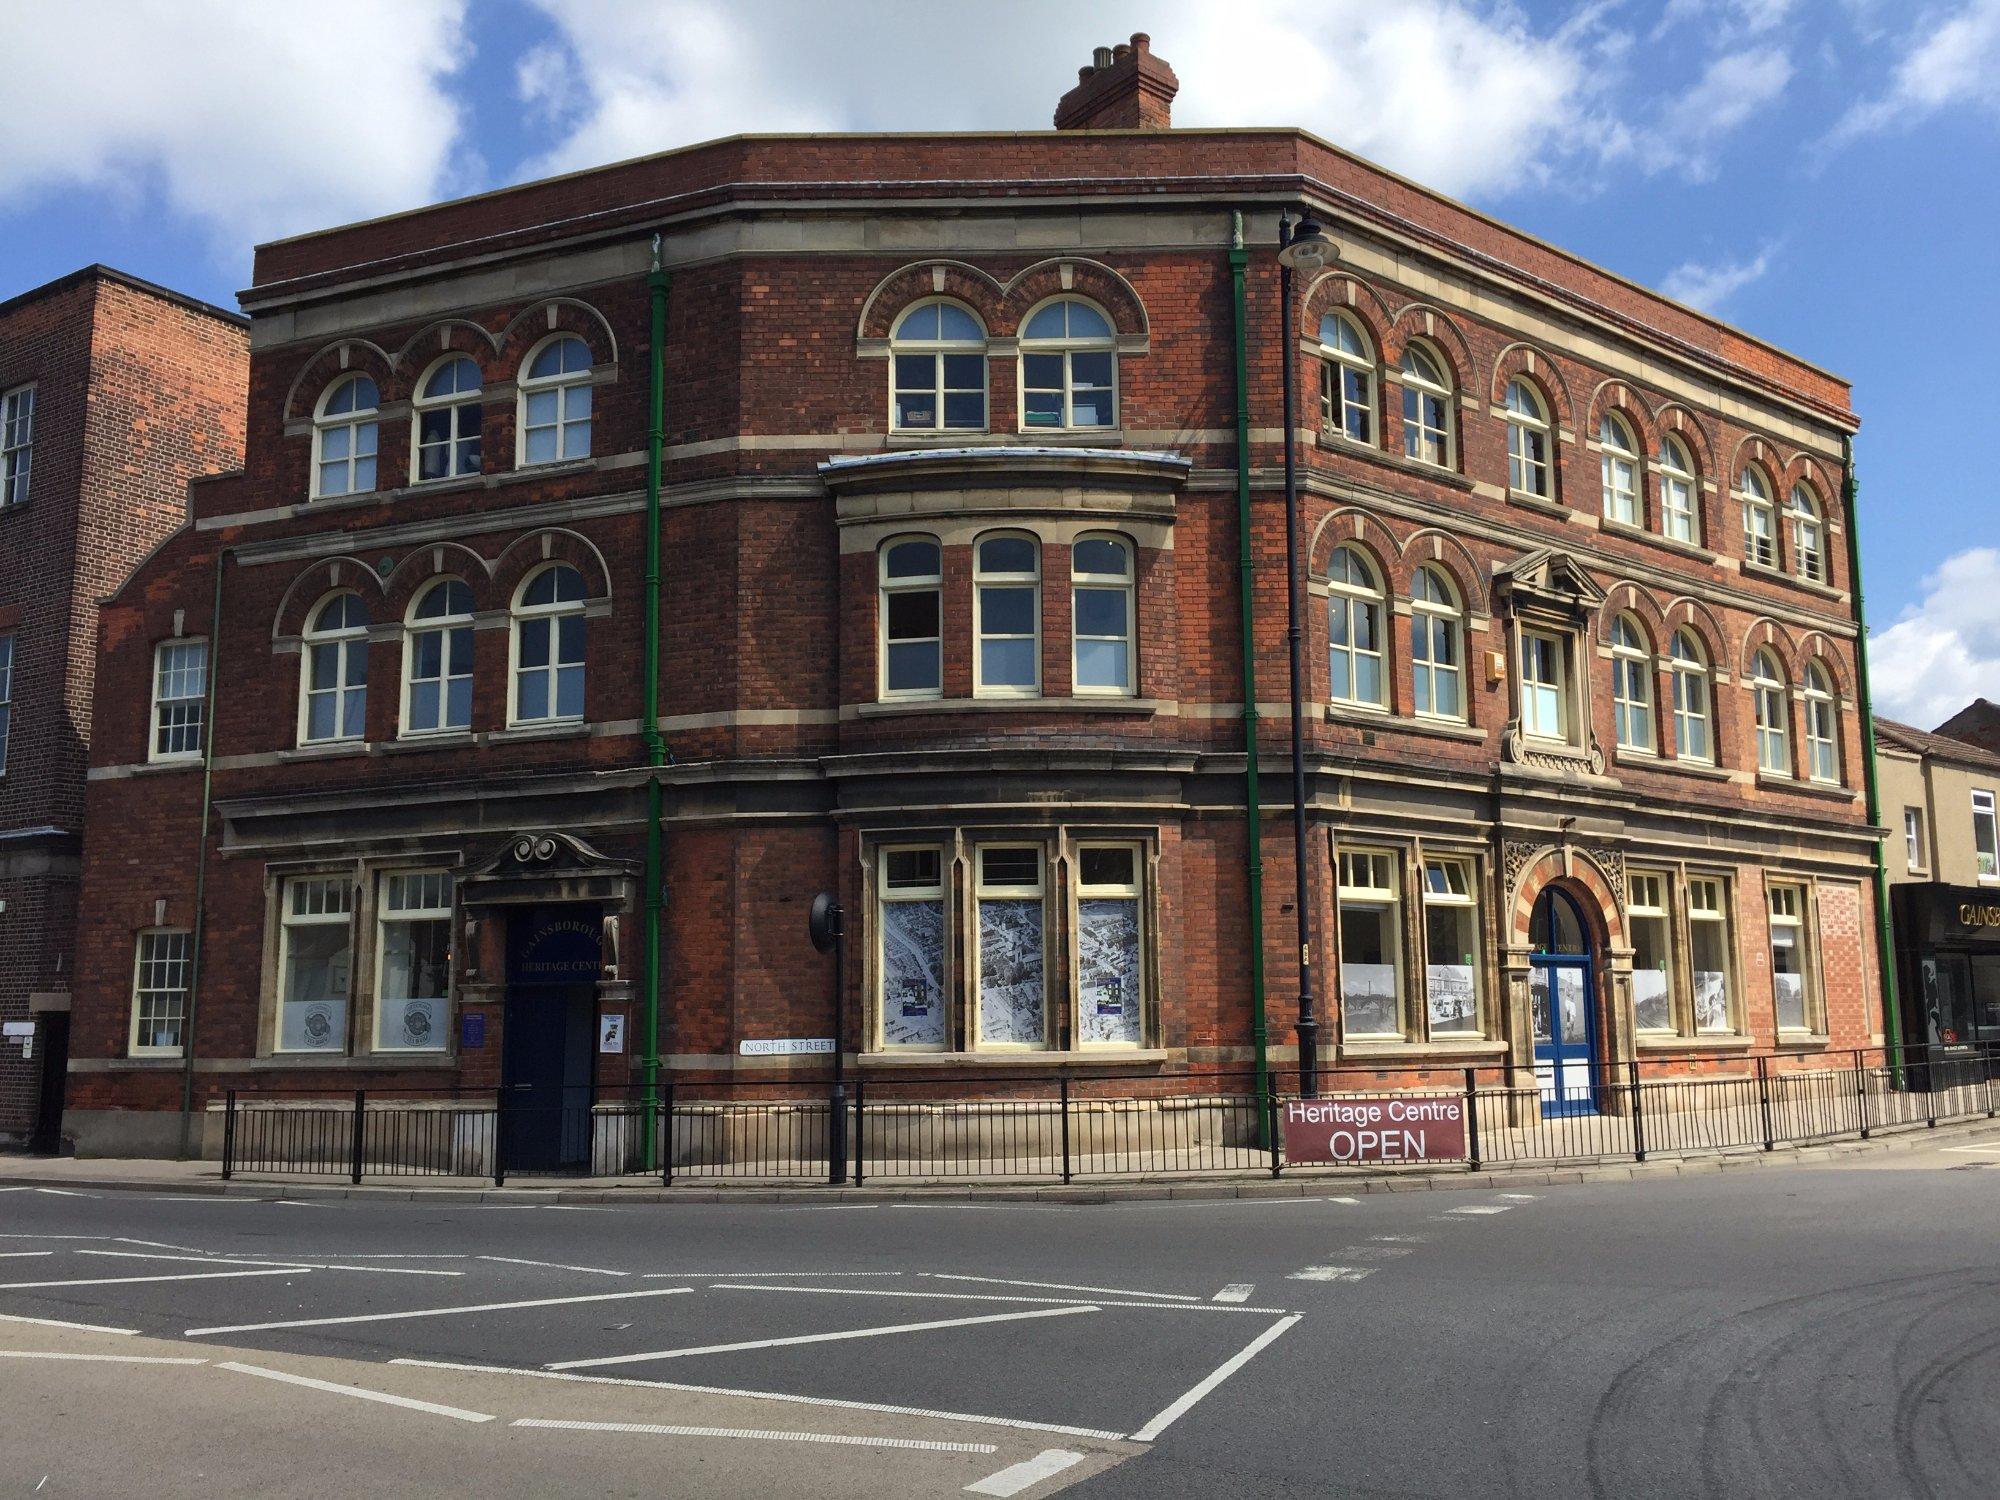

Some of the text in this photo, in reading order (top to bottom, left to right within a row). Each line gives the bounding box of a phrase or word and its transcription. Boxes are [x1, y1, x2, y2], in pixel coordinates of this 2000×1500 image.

[521, 920, 603, 958] GAINSBOROUG
[522, 961, 569, 972] HERITAGE
[745, 1040, 834, 1052] NORTH STREET
[1289, 1101, 1460, 1127] Heritage Centre
[1329, 1129, 1425, 1160] OPEN
